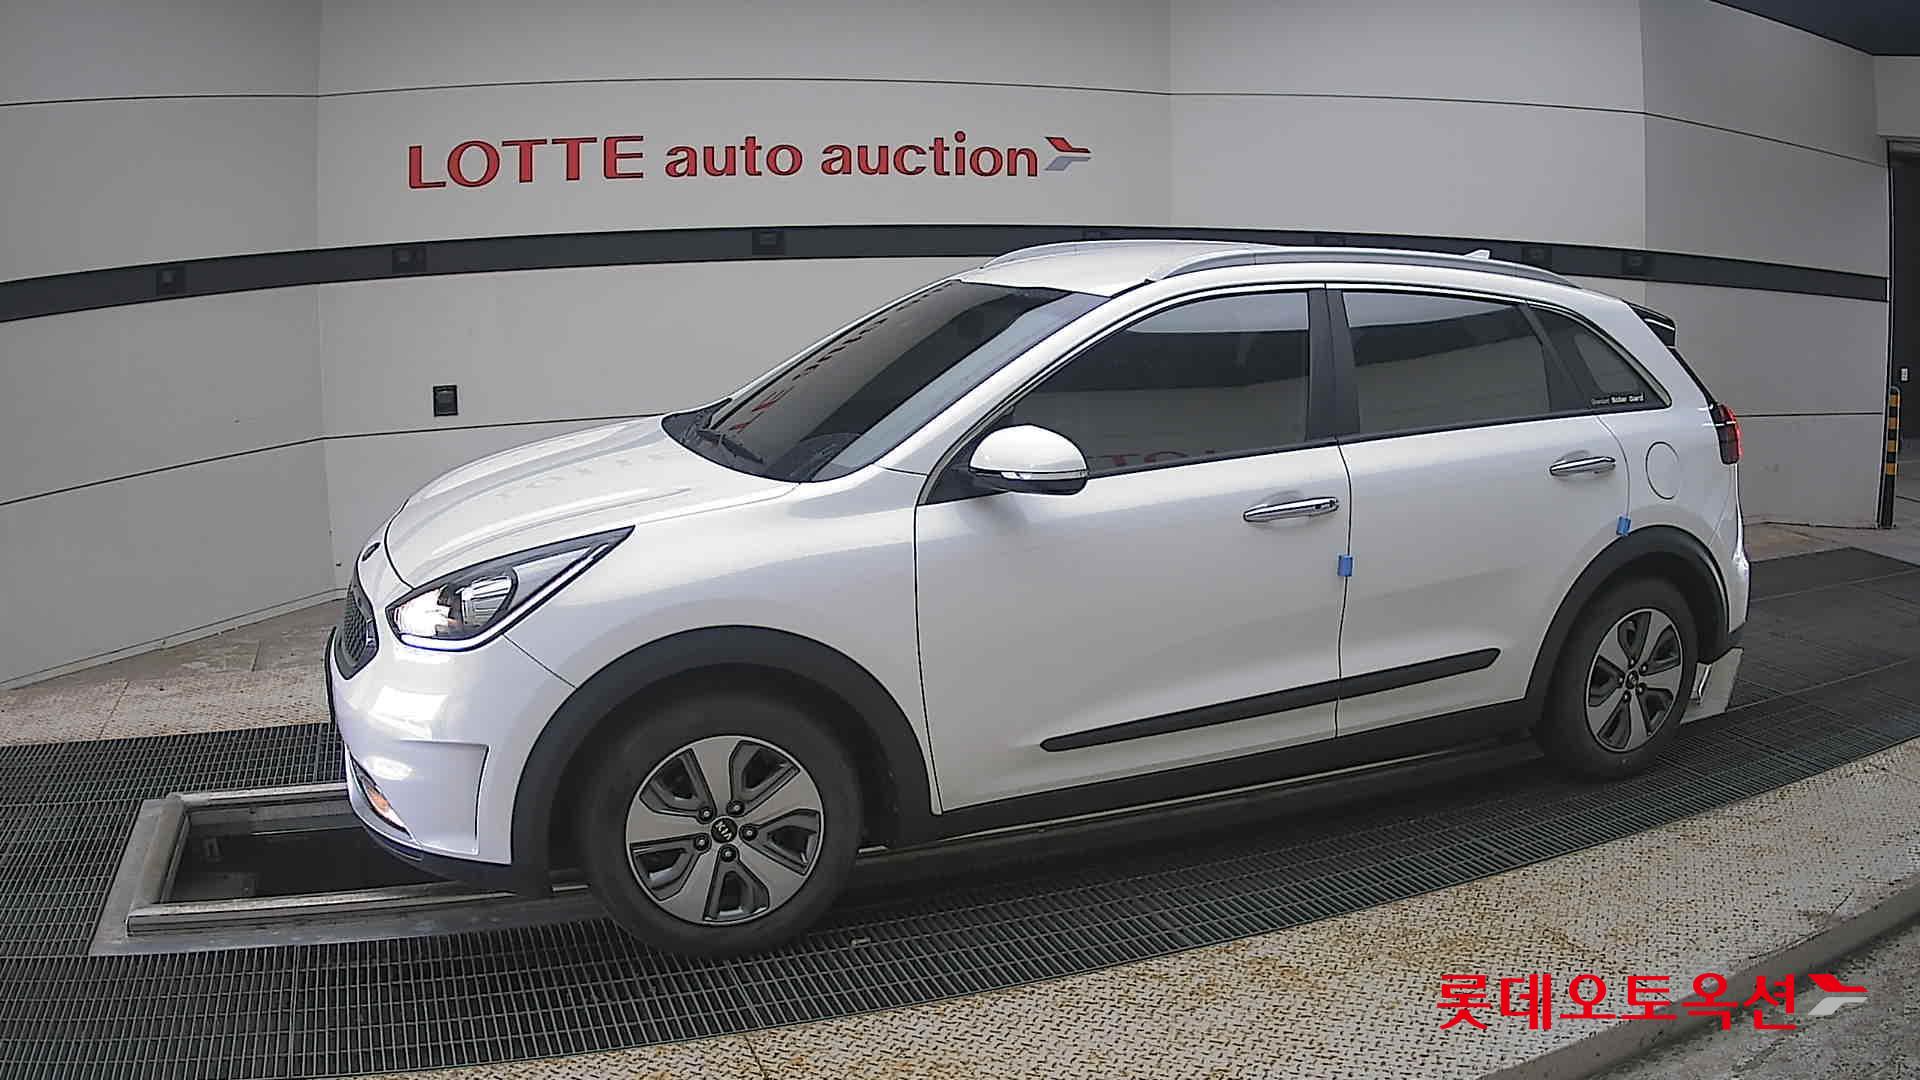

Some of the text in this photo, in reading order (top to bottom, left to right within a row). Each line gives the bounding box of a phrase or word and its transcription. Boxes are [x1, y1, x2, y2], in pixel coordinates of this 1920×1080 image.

[408, 131, 1039, 189] LOTTE auto auction
